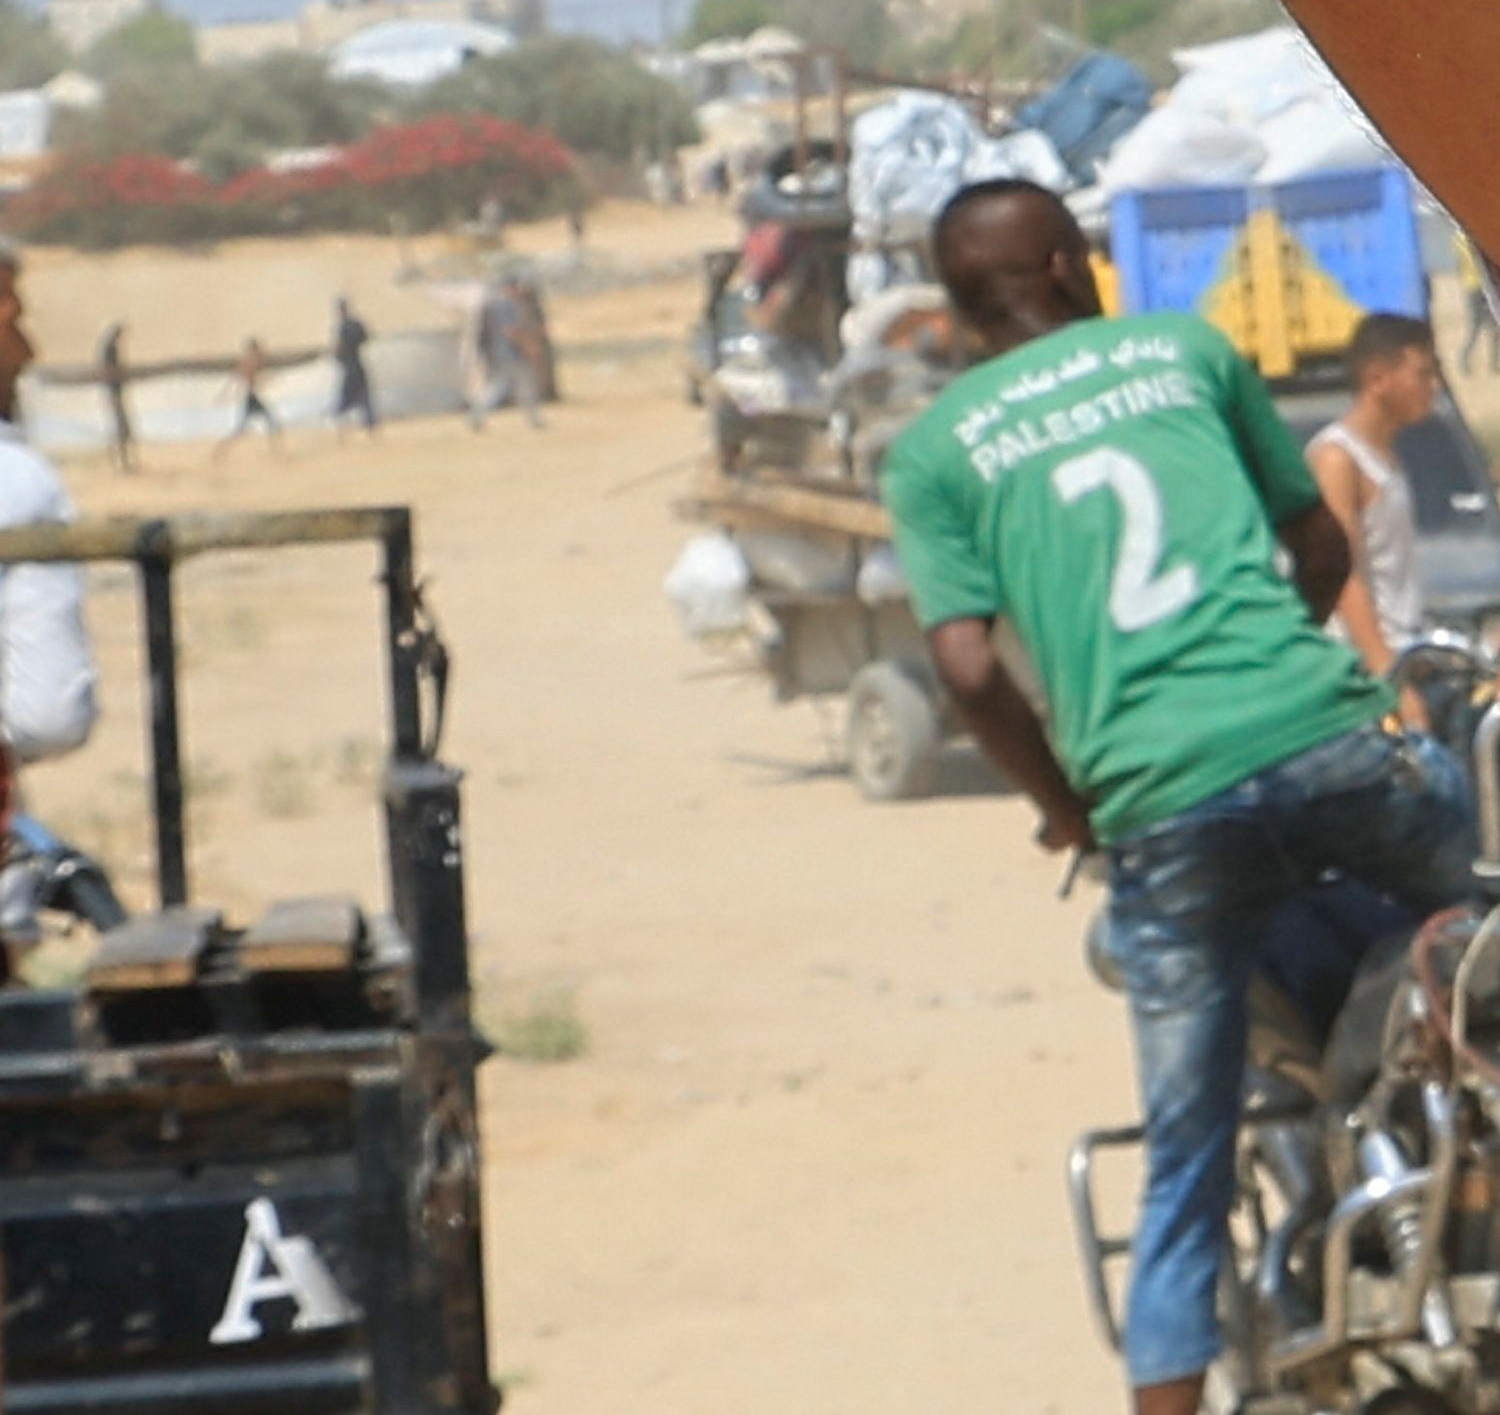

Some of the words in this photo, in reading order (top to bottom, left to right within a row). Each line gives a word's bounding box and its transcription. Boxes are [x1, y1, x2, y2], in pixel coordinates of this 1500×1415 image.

[970, 372, 1197, 483] PALESTINE
[1051, 446, 1198, 633] 2
[208, 1196, 364, 1344] A
